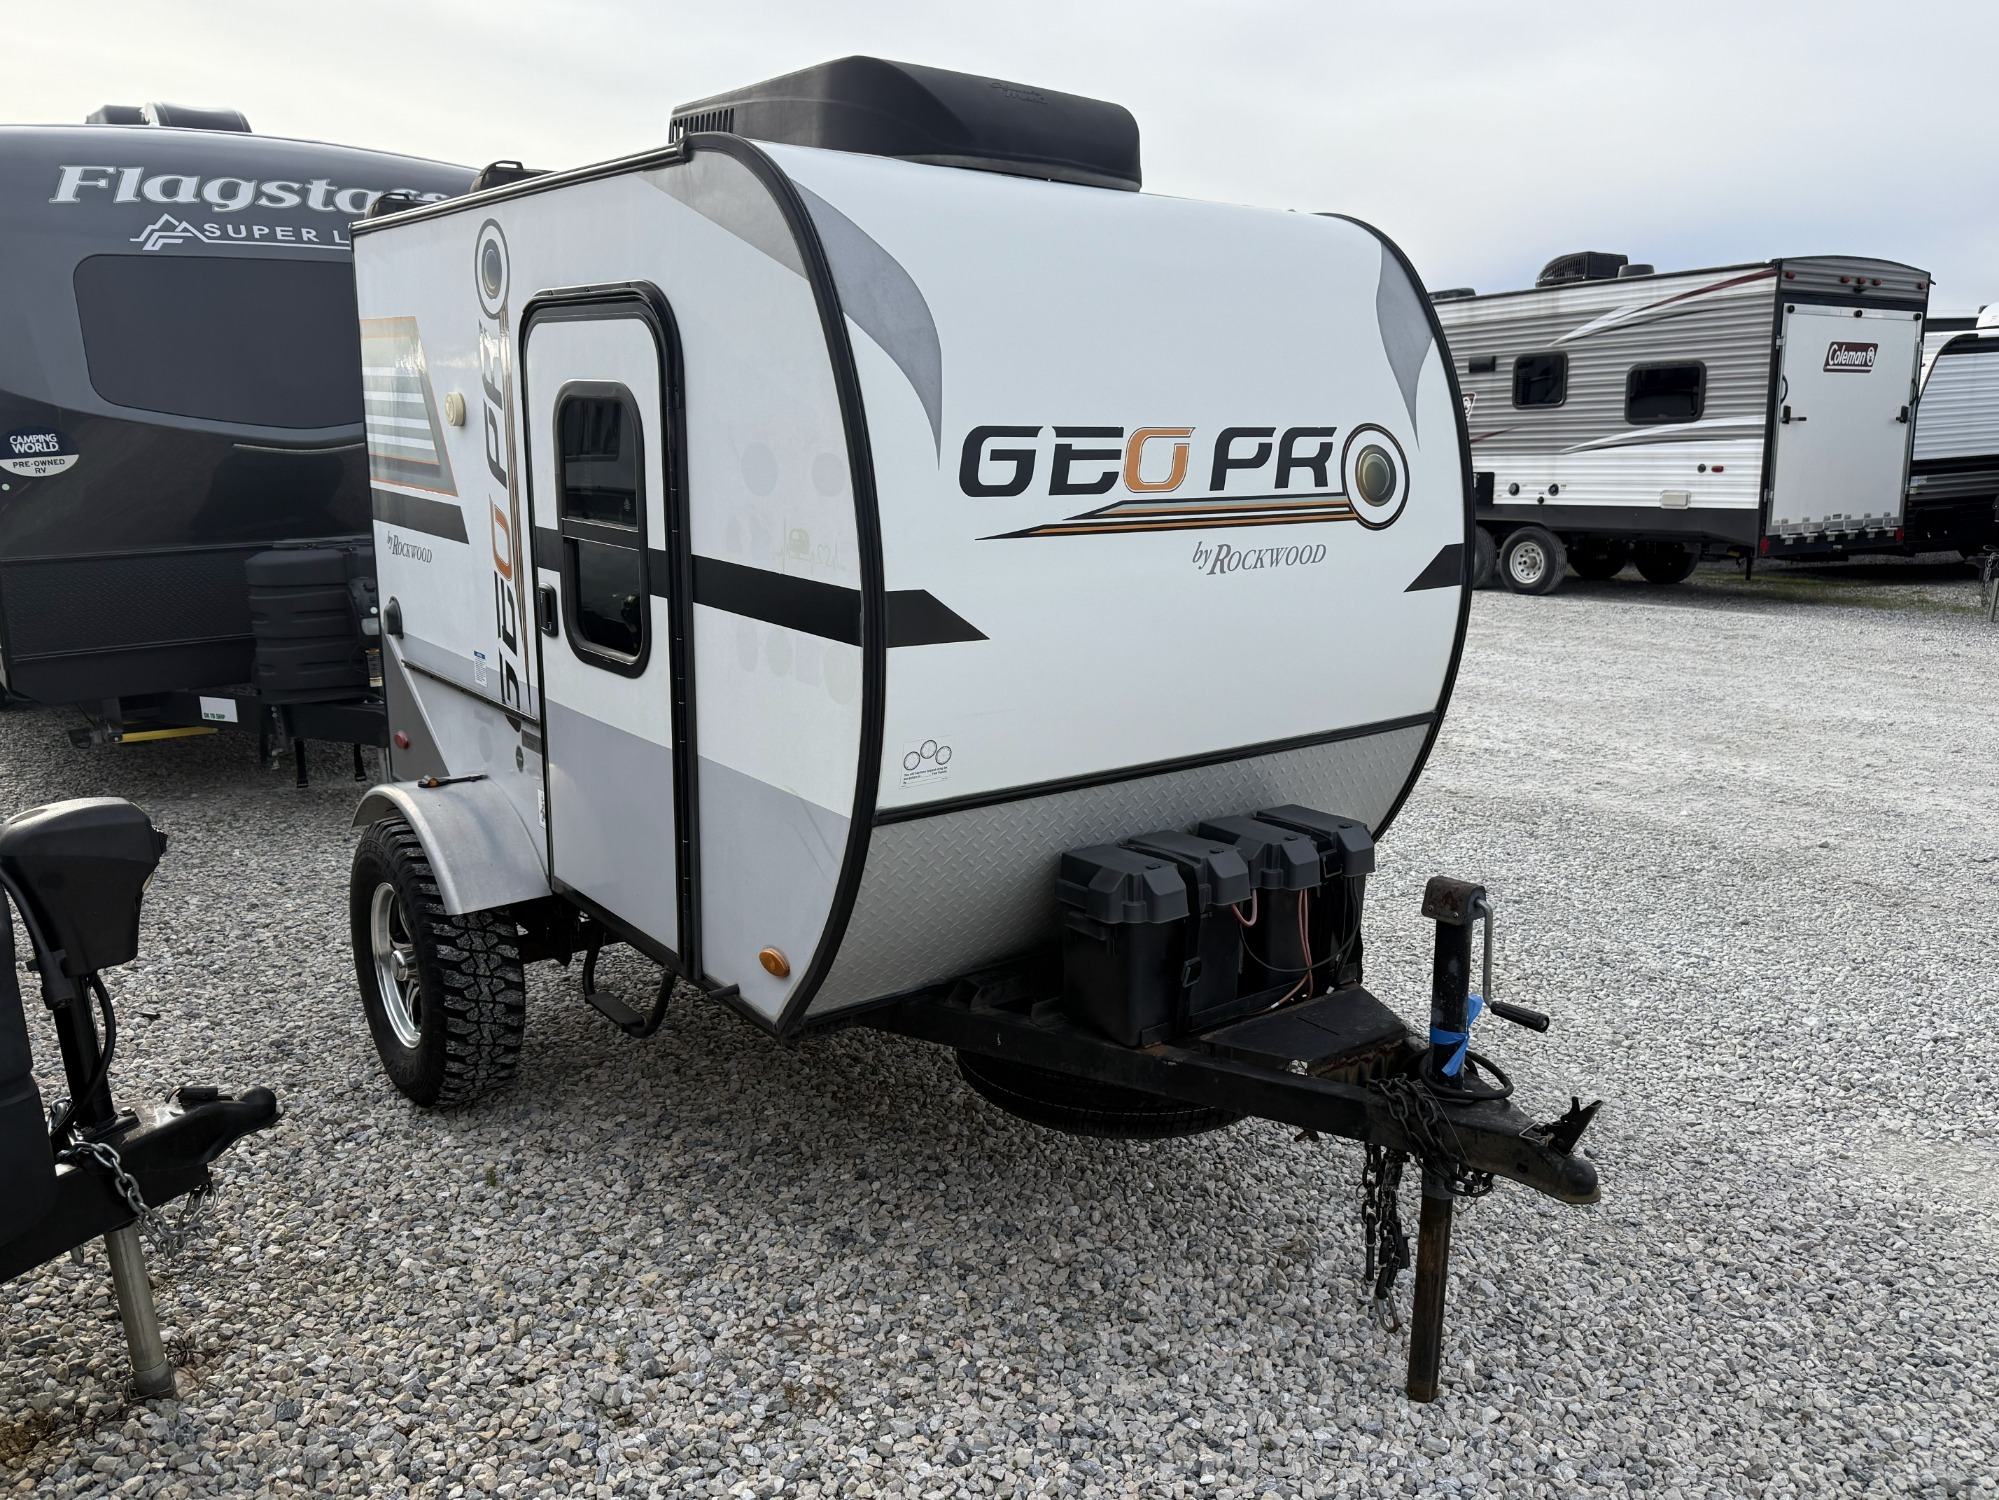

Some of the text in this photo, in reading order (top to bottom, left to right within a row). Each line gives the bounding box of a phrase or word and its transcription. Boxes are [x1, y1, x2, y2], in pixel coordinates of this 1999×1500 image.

[205, 222, 318, 242] SUPER
[1828, 344, 1866, 365] Coleman
[9, 433, 57, 444] CAMPING
[11, 442, 59, 453] WORLD
[13, 459, 65, 468] PRE-OWNED
[959, 423, 1410, 531] GEO PRO
[1192, 541, 1327, 575] by ROCKWOOD
